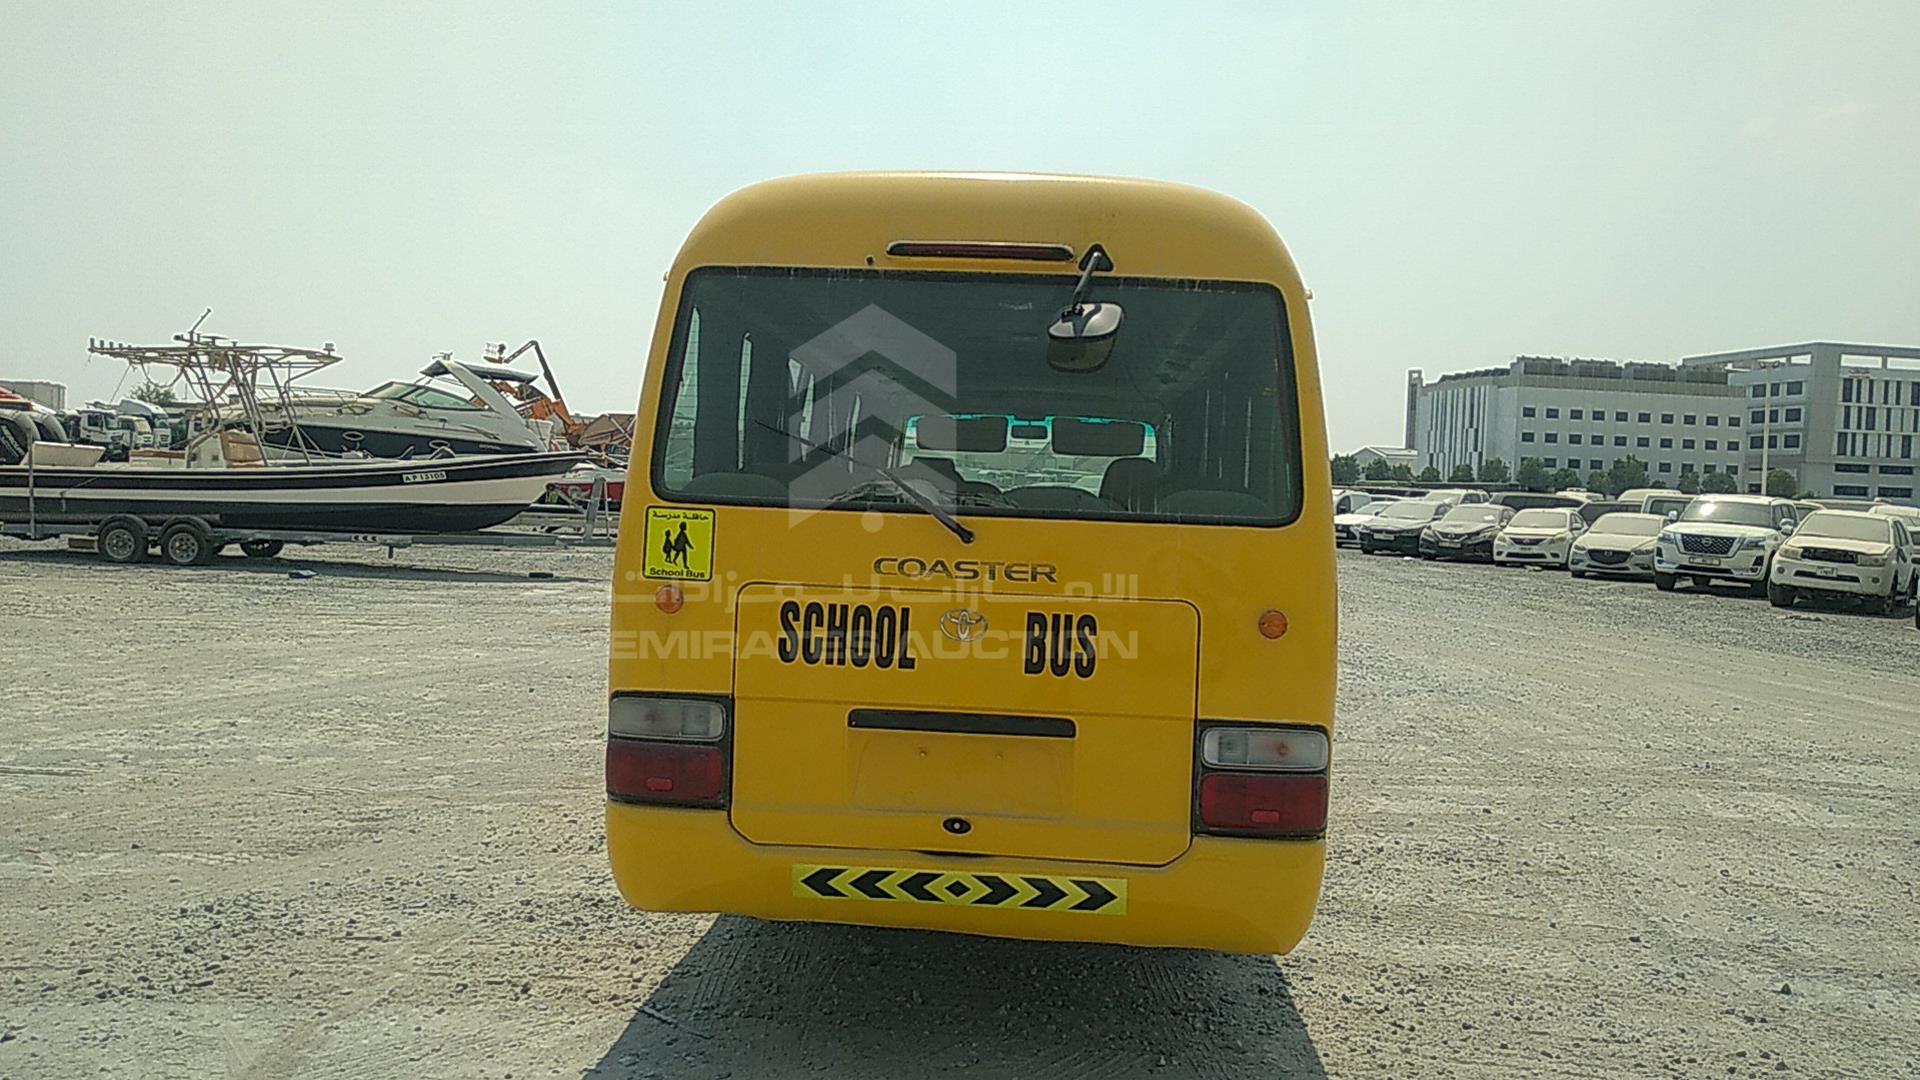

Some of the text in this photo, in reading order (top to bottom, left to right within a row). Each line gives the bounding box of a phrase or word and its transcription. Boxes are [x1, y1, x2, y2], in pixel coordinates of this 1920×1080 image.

[649, 567, 705, 578] School Bus
[873, 557, 1057, 583] COASTER
[778, 600, 1098, 679] SCHOOL BUS
